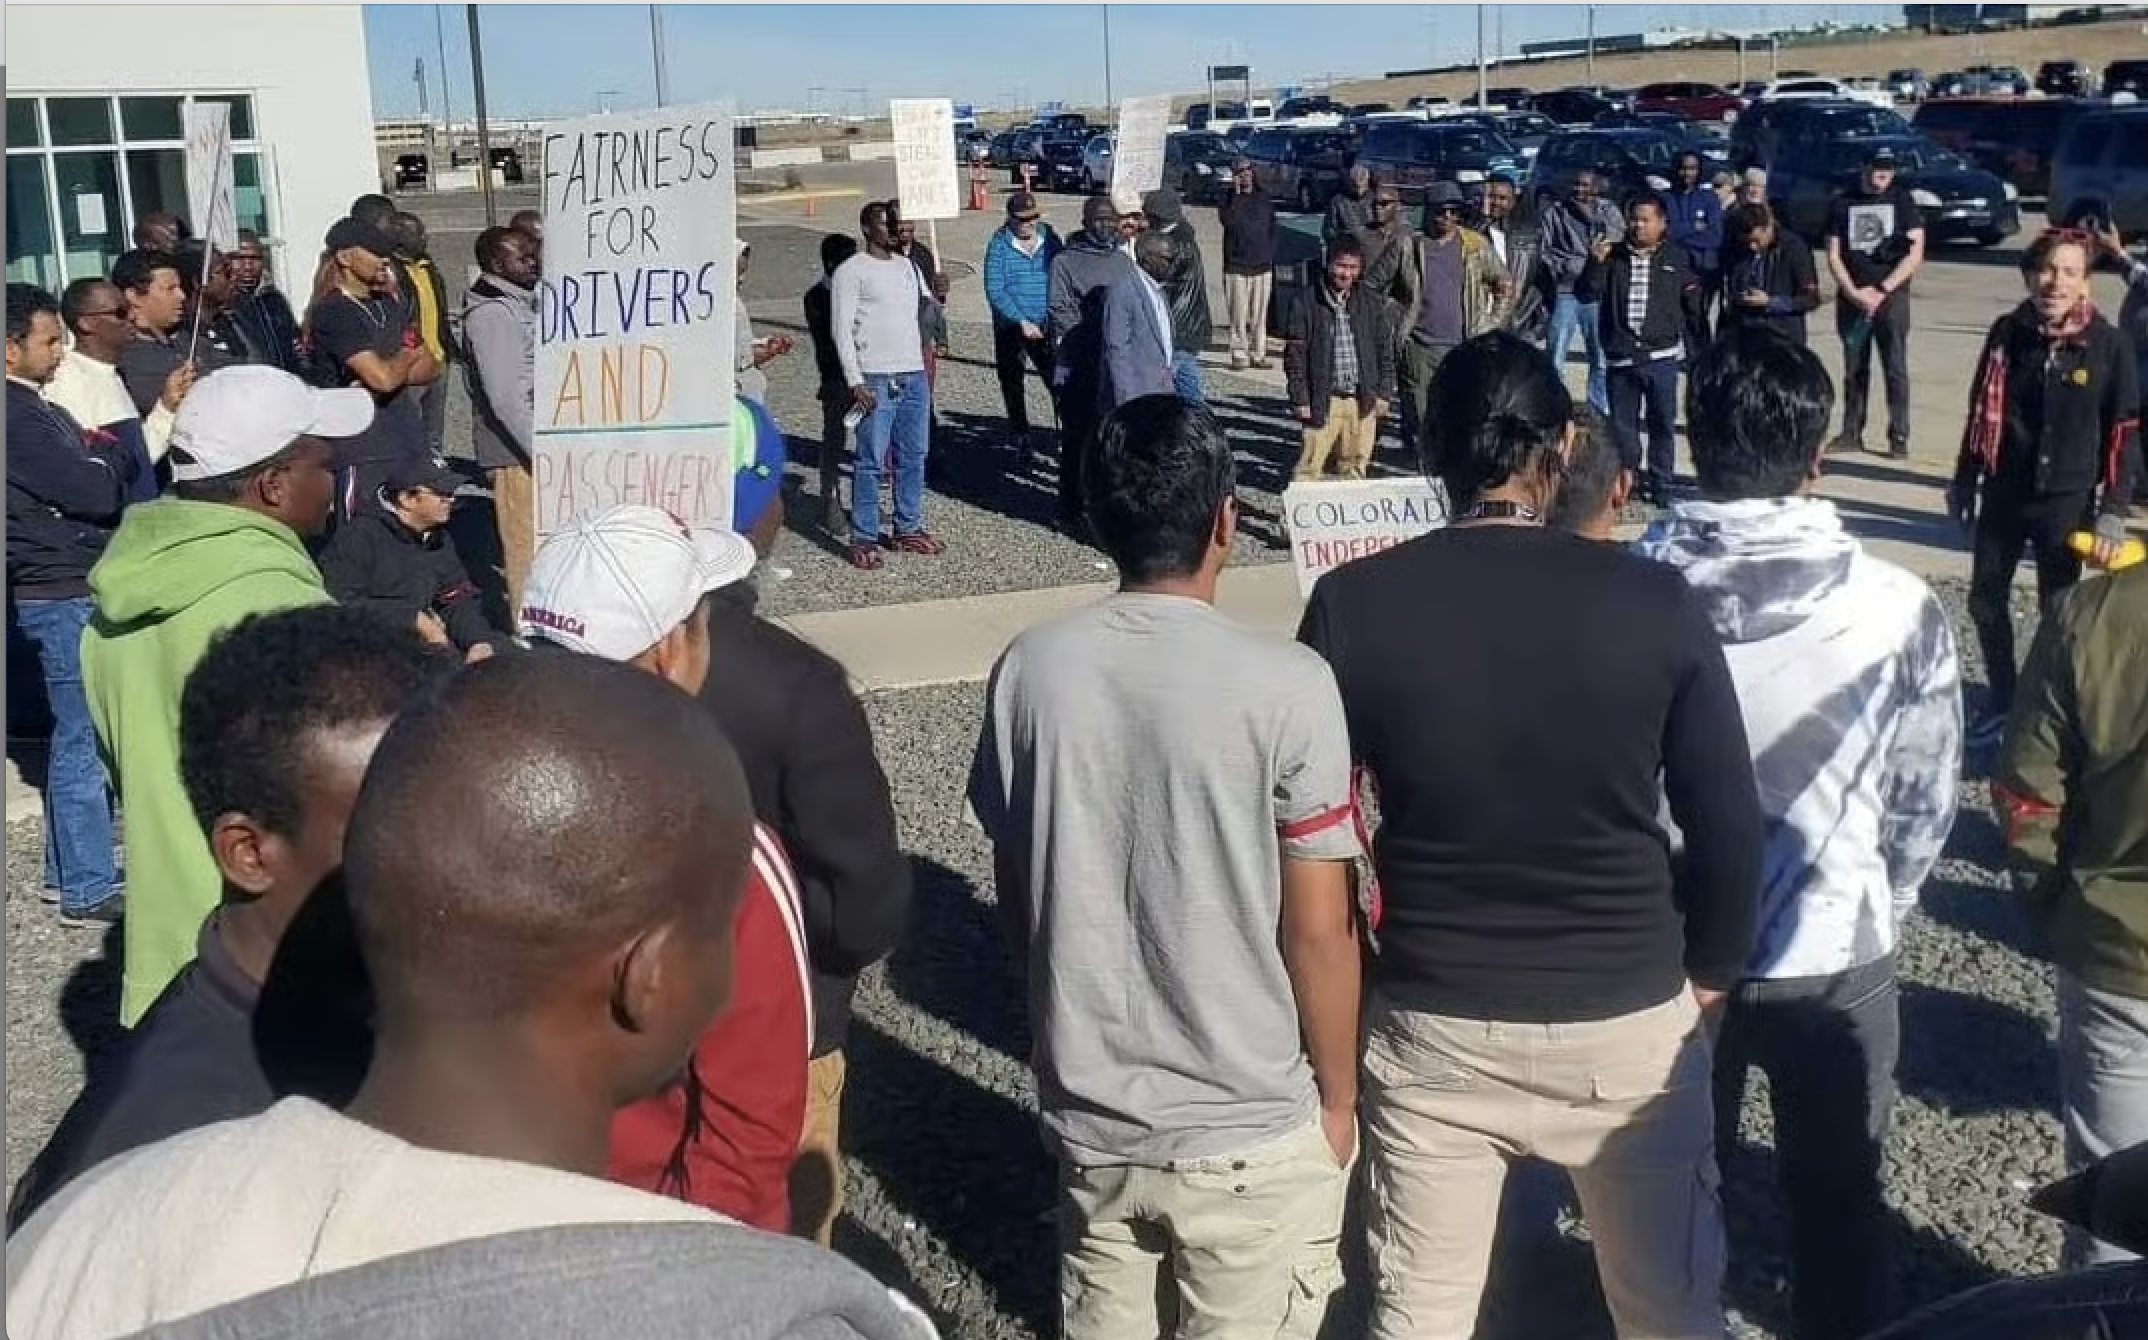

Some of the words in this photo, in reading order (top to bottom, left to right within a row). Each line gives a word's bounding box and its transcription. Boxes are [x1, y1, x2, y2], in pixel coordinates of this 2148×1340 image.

[543, 121, 719, 216] FAIRNESS
[587, 204, 660, 259] FOR
[541, 261, 716, 345] DRIVERS
[552, 343, 669, 427] AND
